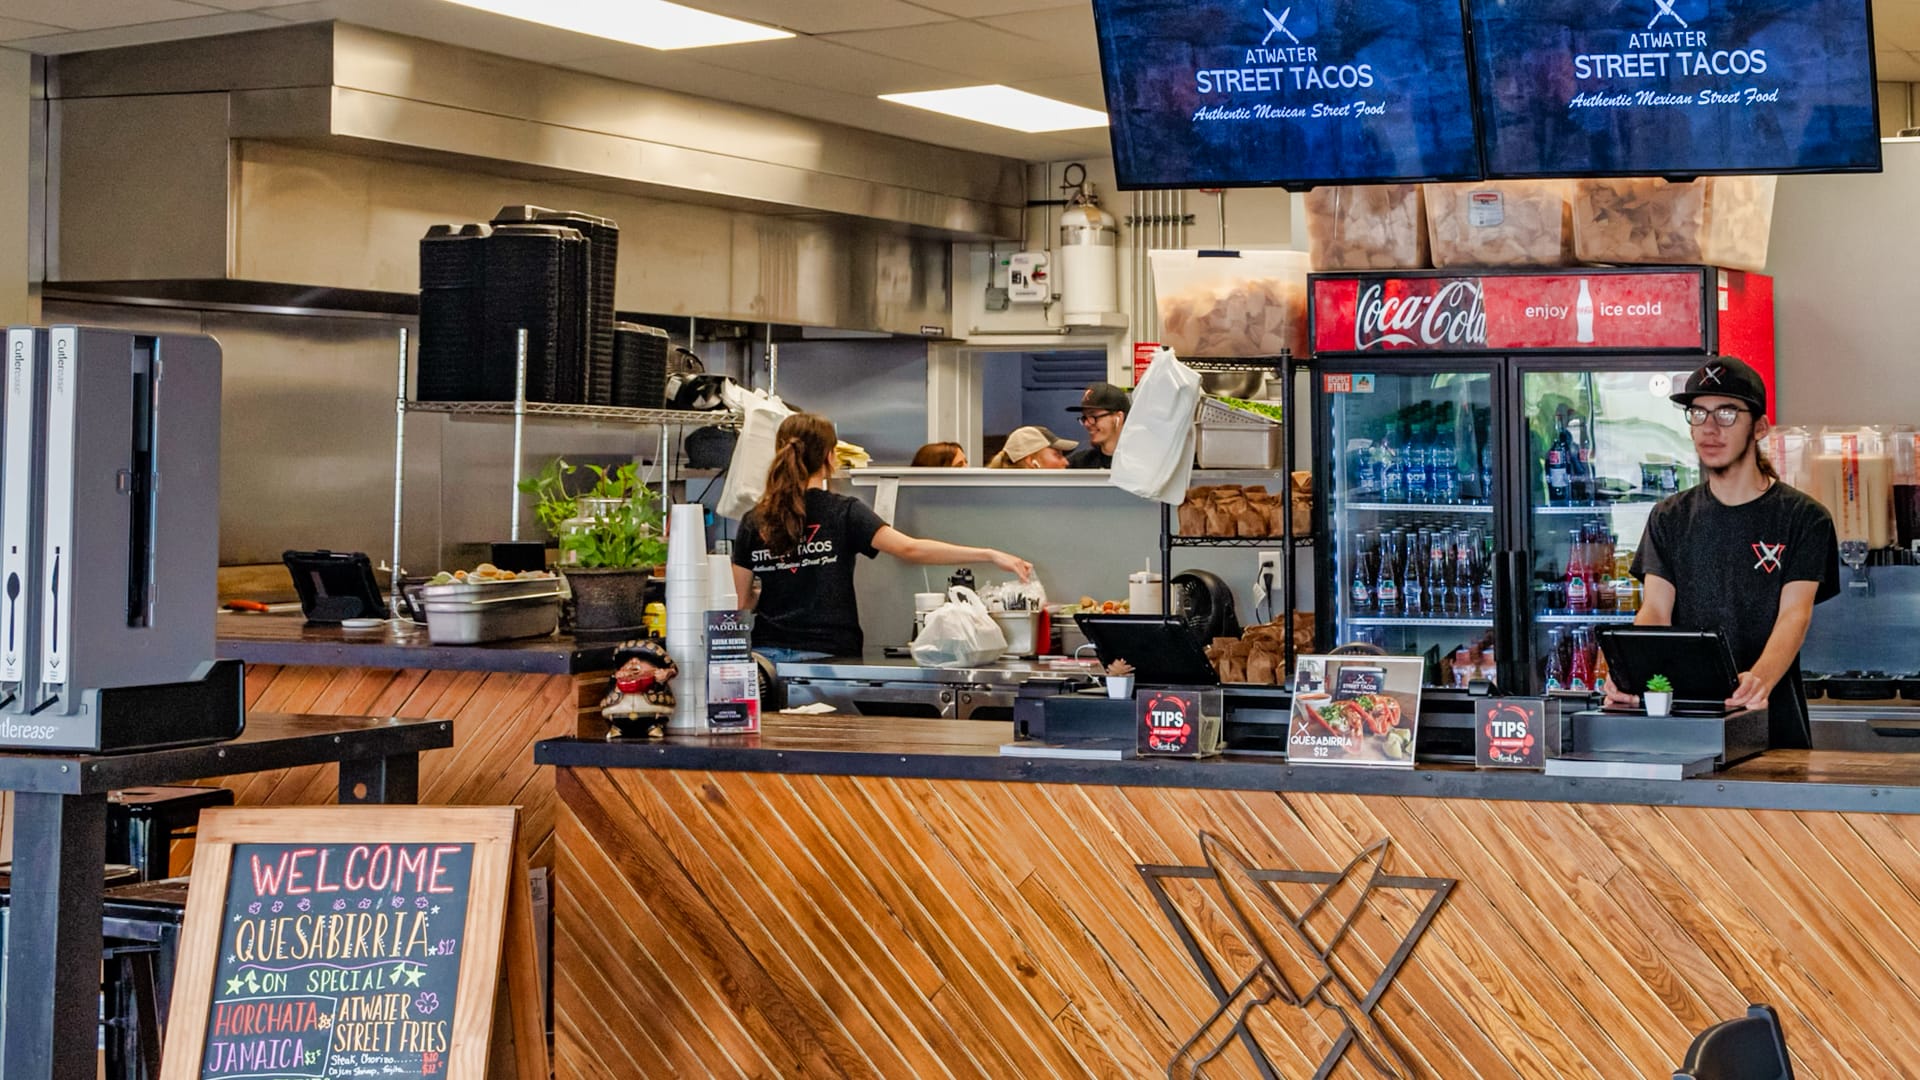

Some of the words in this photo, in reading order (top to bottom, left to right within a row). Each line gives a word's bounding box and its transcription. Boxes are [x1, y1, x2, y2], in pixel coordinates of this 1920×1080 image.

[1629, 31, 1708, 48] ATWATER
[1245, 47, 1318, 64] ATWATER
[1574, 53, 1670, 79] STREET
[1676, 49, 1768, 76] TACOS
[1196, 68, 1284, 93] STREET
[1289, 64, 1374, 90] TACOS
[1569, 92, 1633, 108] Authentic
[1635, 90, 1692, 106] Mexican
[1697, 89, 1740, 105] Street
[1743, 87, 1779, 105] Food
[1192, 105, 1251, 121] Authentic
[1253, 104, 1306, 119] Mexican
[1311, 103, 1350, 118] Street
[1353, 101, 1386, 118] Food
[1355, 281, 1486, 350] Coca-Cola
[1525, 304, 1568, 320] enjoy
[1600, 302, 1624, 316] ice
[1626, 301, 1662, 316] cold
[708, 623, 750, 632] PADDLES
[1151, 710, 1184, 728] TIPS
[1491, 721, 1527, 738] TIPS
[1290, 736, 1352, 747] QUESABIRRIA
[1313, 747, 1329, 757] $12
[251, 844, 462, 897] WELCOME
[235, 910, 428, 962] QUESABIRRIA
[437, 938, 456, 955] $12
[262, 973, 287, 992] ON
[306, 967, 386, 992] SPECIAL
[338, 993, 411, 1021] ATWATER
[214, 1001, 318, 1037] HORCHATA
[334, 1021, 395, 1052] STREET
[400, 1020, 447, 1052] FRIES
[209, 1038, 305, 1072] JAMAICA
